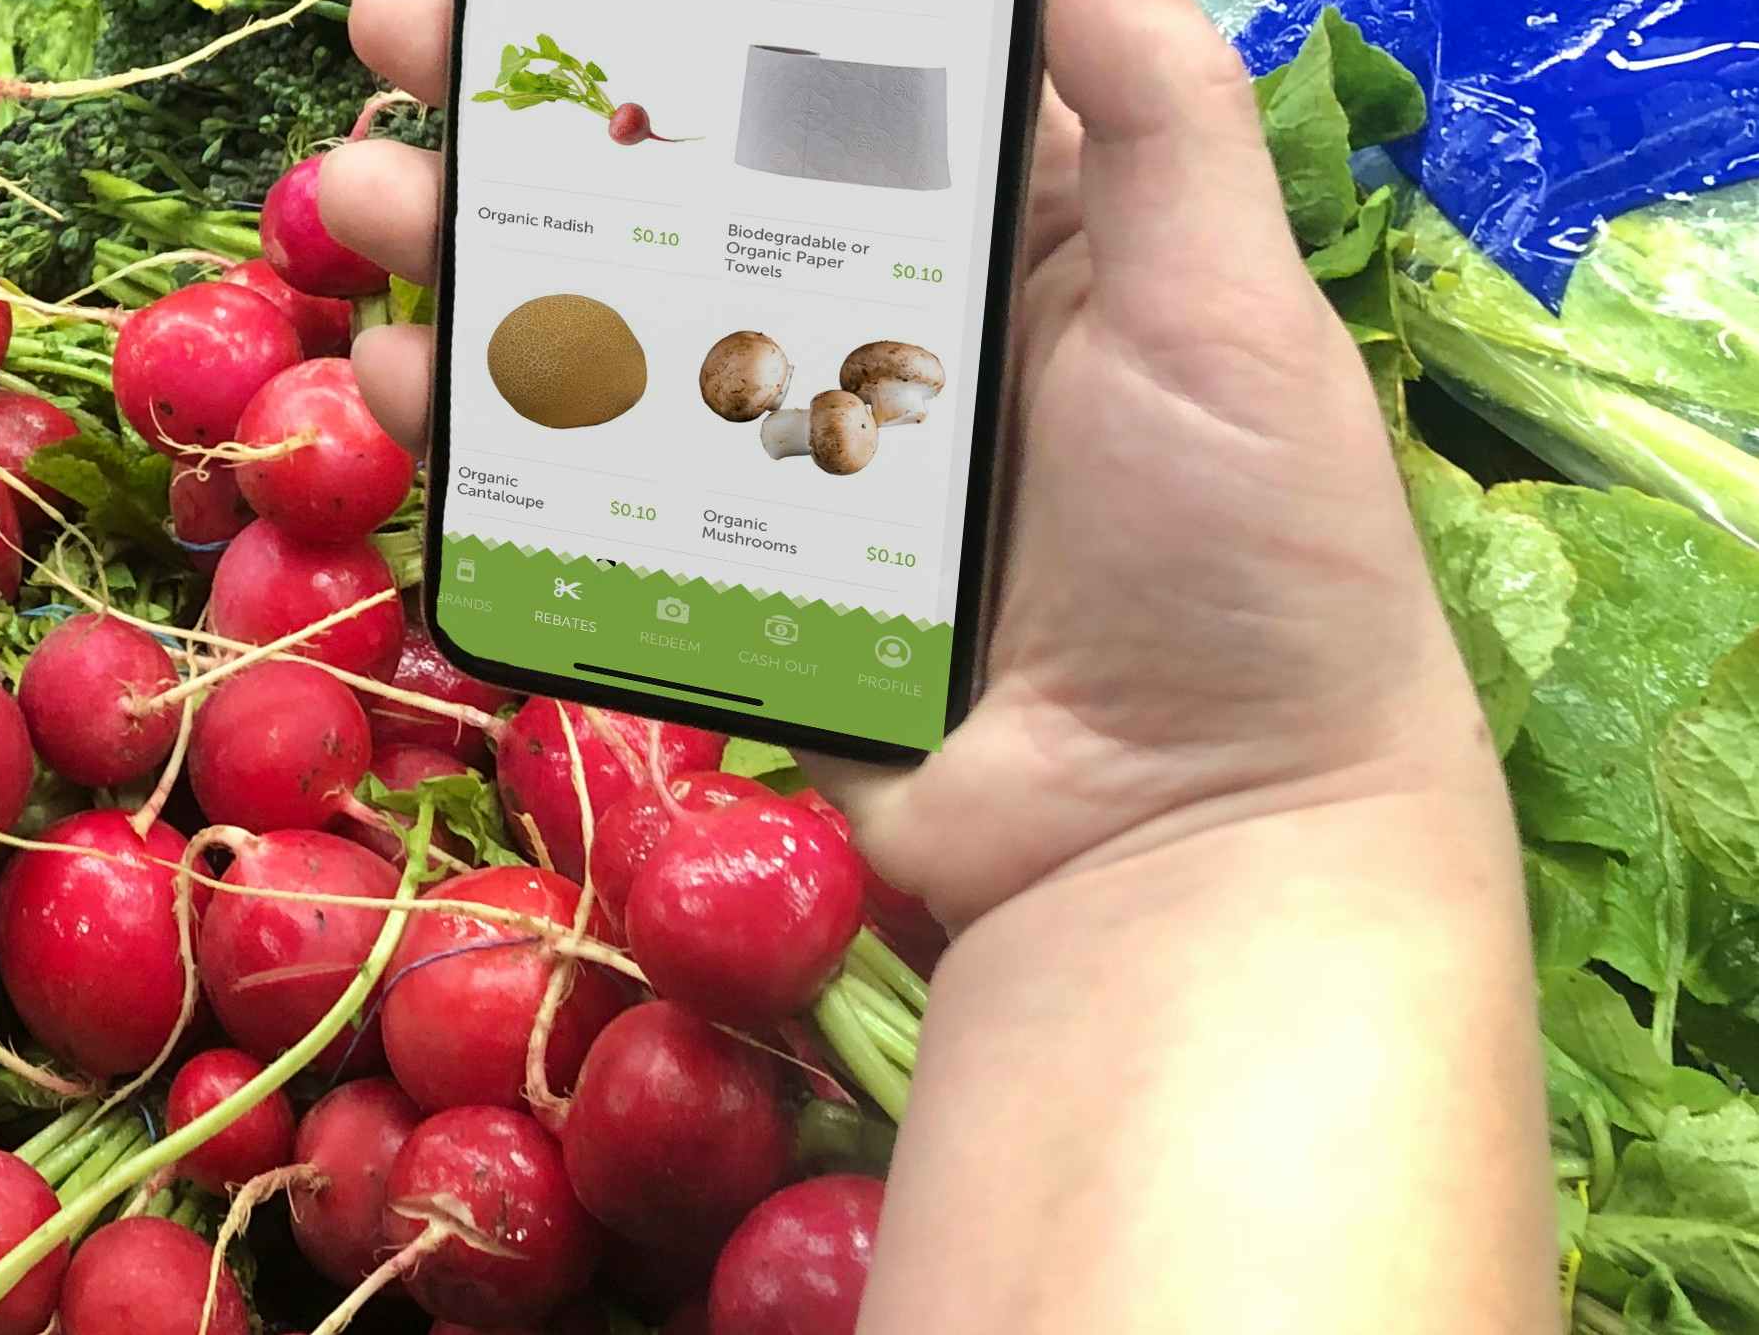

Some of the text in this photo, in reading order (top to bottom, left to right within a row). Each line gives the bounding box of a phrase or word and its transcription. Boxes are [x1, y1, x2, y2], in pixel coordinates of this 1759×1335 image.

[477, 206, 594, 235] Organic Radish
[632, 226, 681, 248] $0.10
[727, 223, 871, 256] Biodegradable or
[726, 241, 845, 270] Organic Paper
[724, 258, 783, 279] Towels
[891, 262, 944, 284] $0.10
[457, 466, 519, 488] Organic
[456, 482, 545, 510] Cantaloupe
[609, 500, 658, 522] $0.10
[702, 509, 769, 533] Organic
[700, 525, 799, 556] Mushrooms
[865, 545, 917, 569] $0.10
[437, 591, 493, 613] BRANDS
[534, 610, 598, 634] REBATES
[639, 630, 703, 654] REDEEM
[737, 650, 819, 677] CASH OUT
[857, 672, 924, 698] PROFILE
